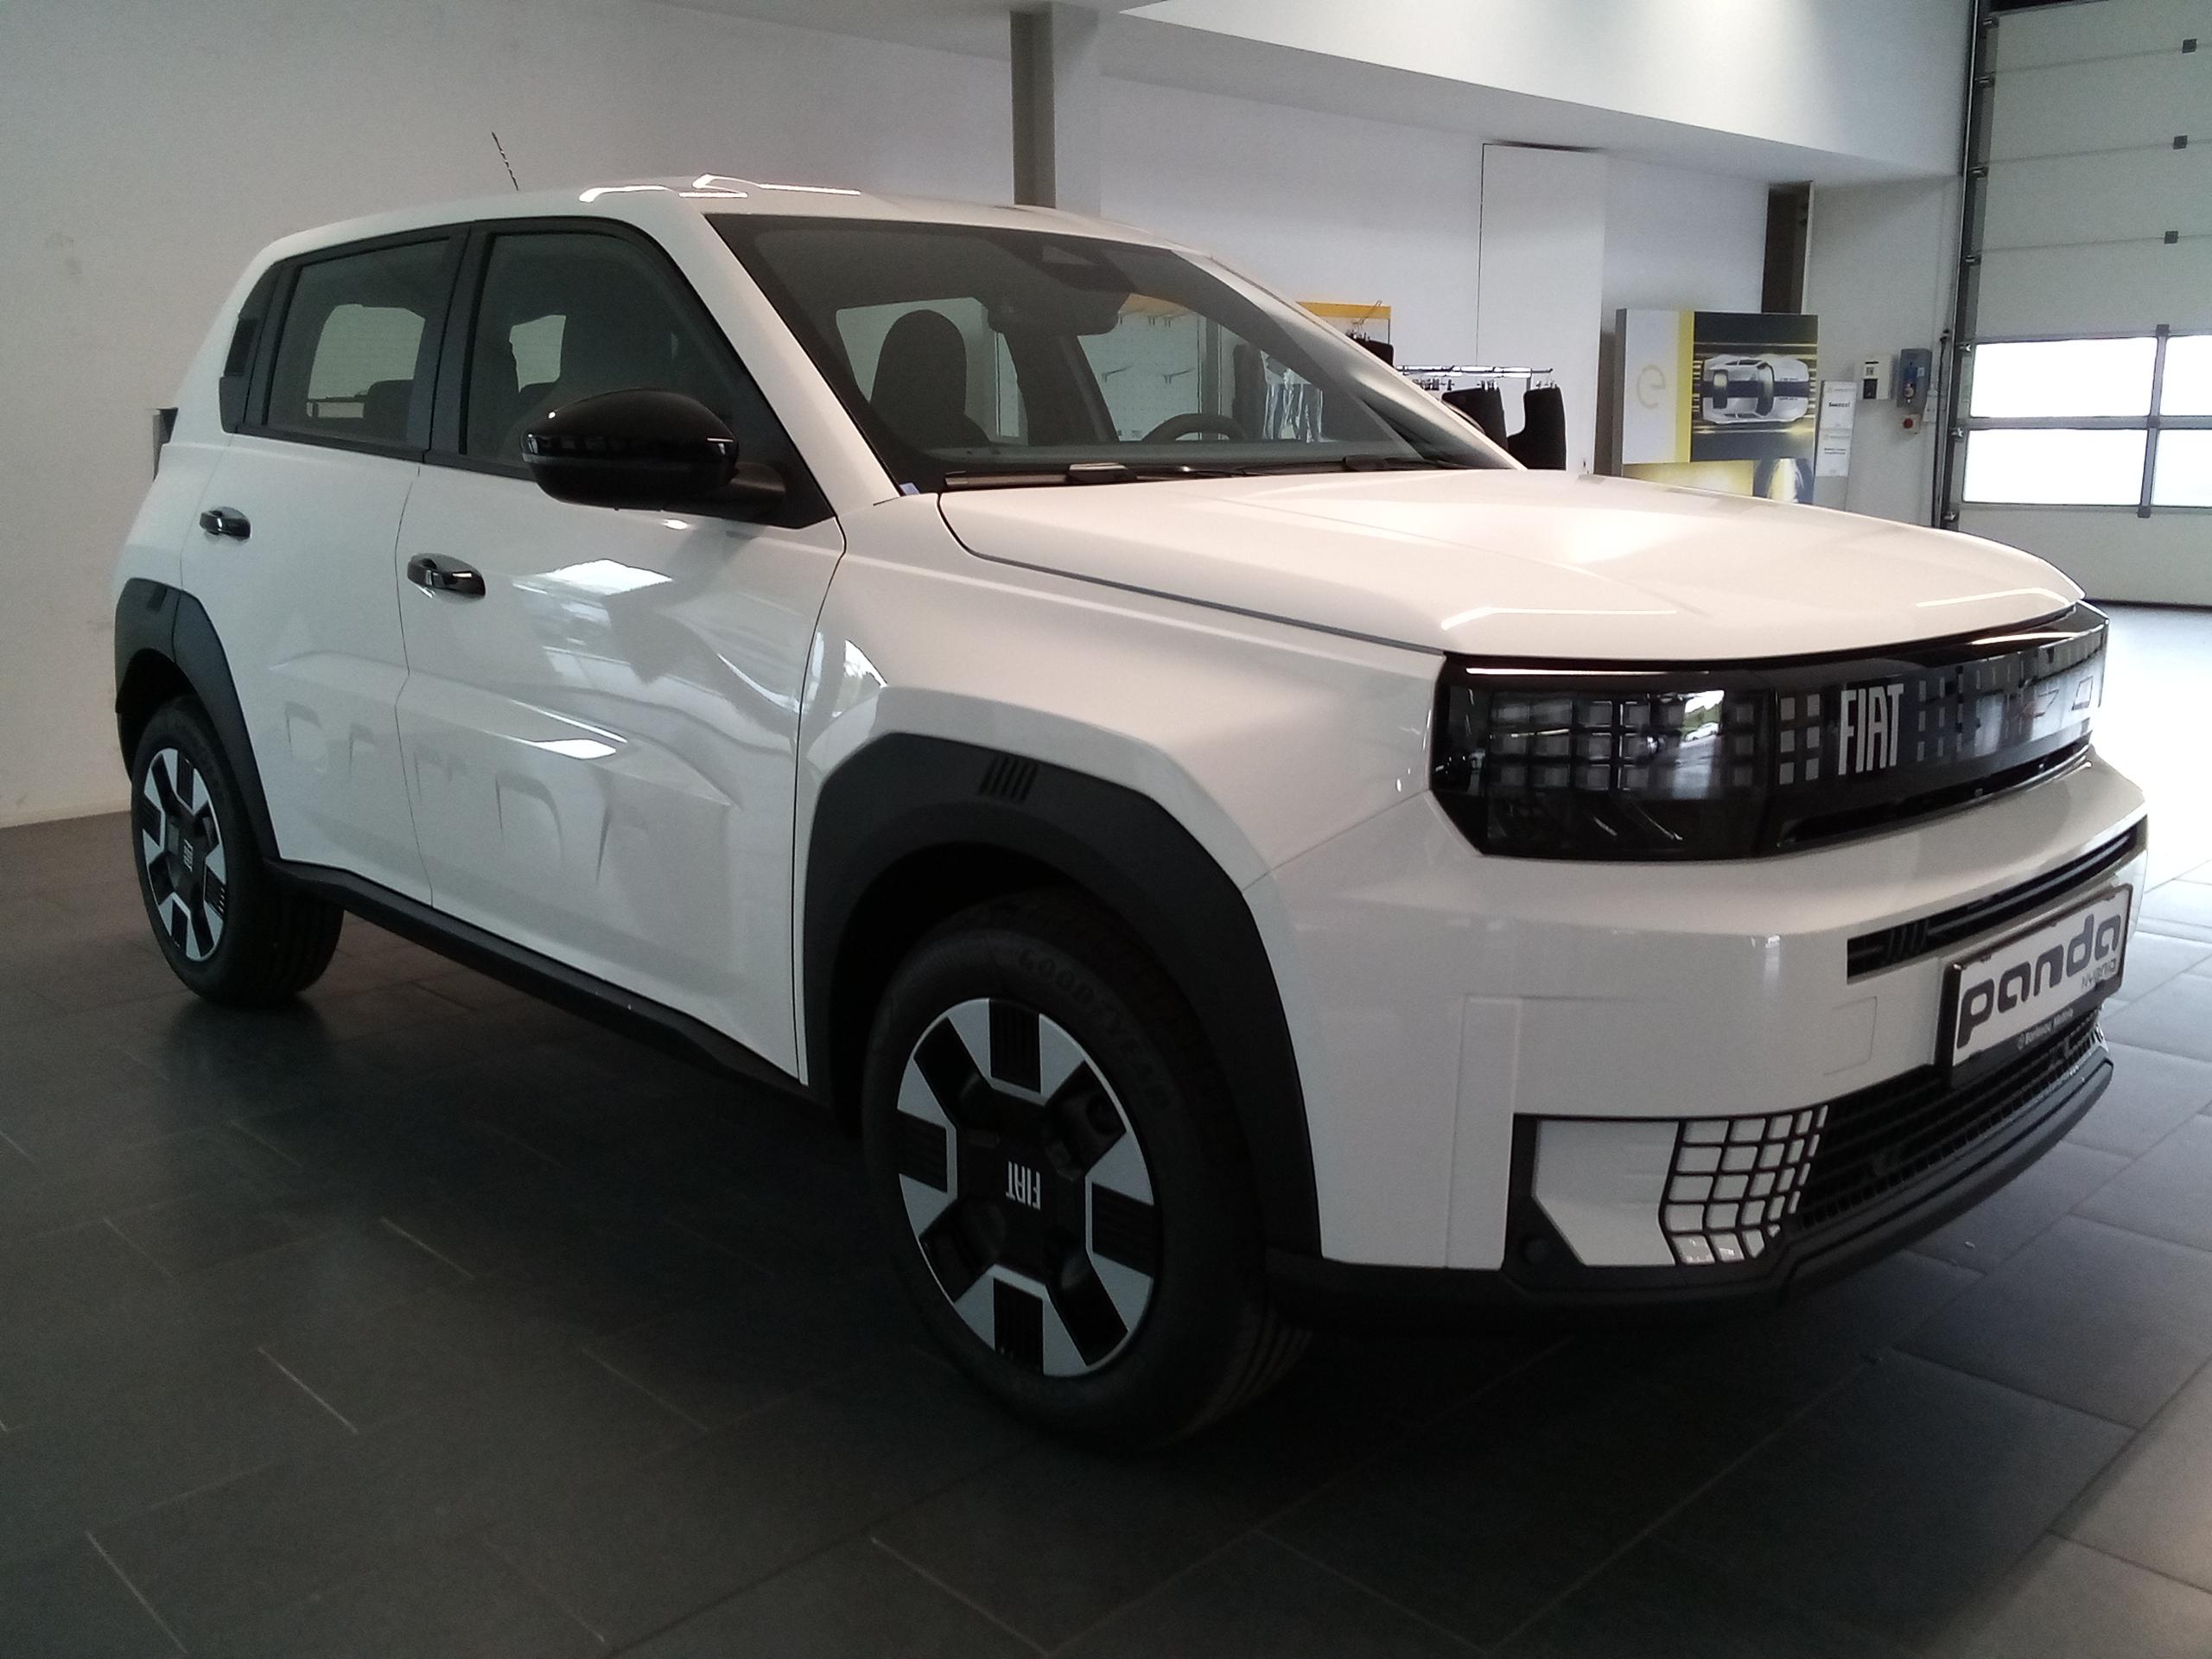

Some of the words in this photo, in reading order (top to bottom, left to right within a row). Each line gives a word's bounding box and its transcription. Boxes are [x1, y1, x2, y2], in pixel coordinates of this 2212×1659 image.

[1838, 683, 1904, 776] FIAT
[1956, 913, 2121, 1051] panda
[1005, 1160, 1041, 1211] FIAT
